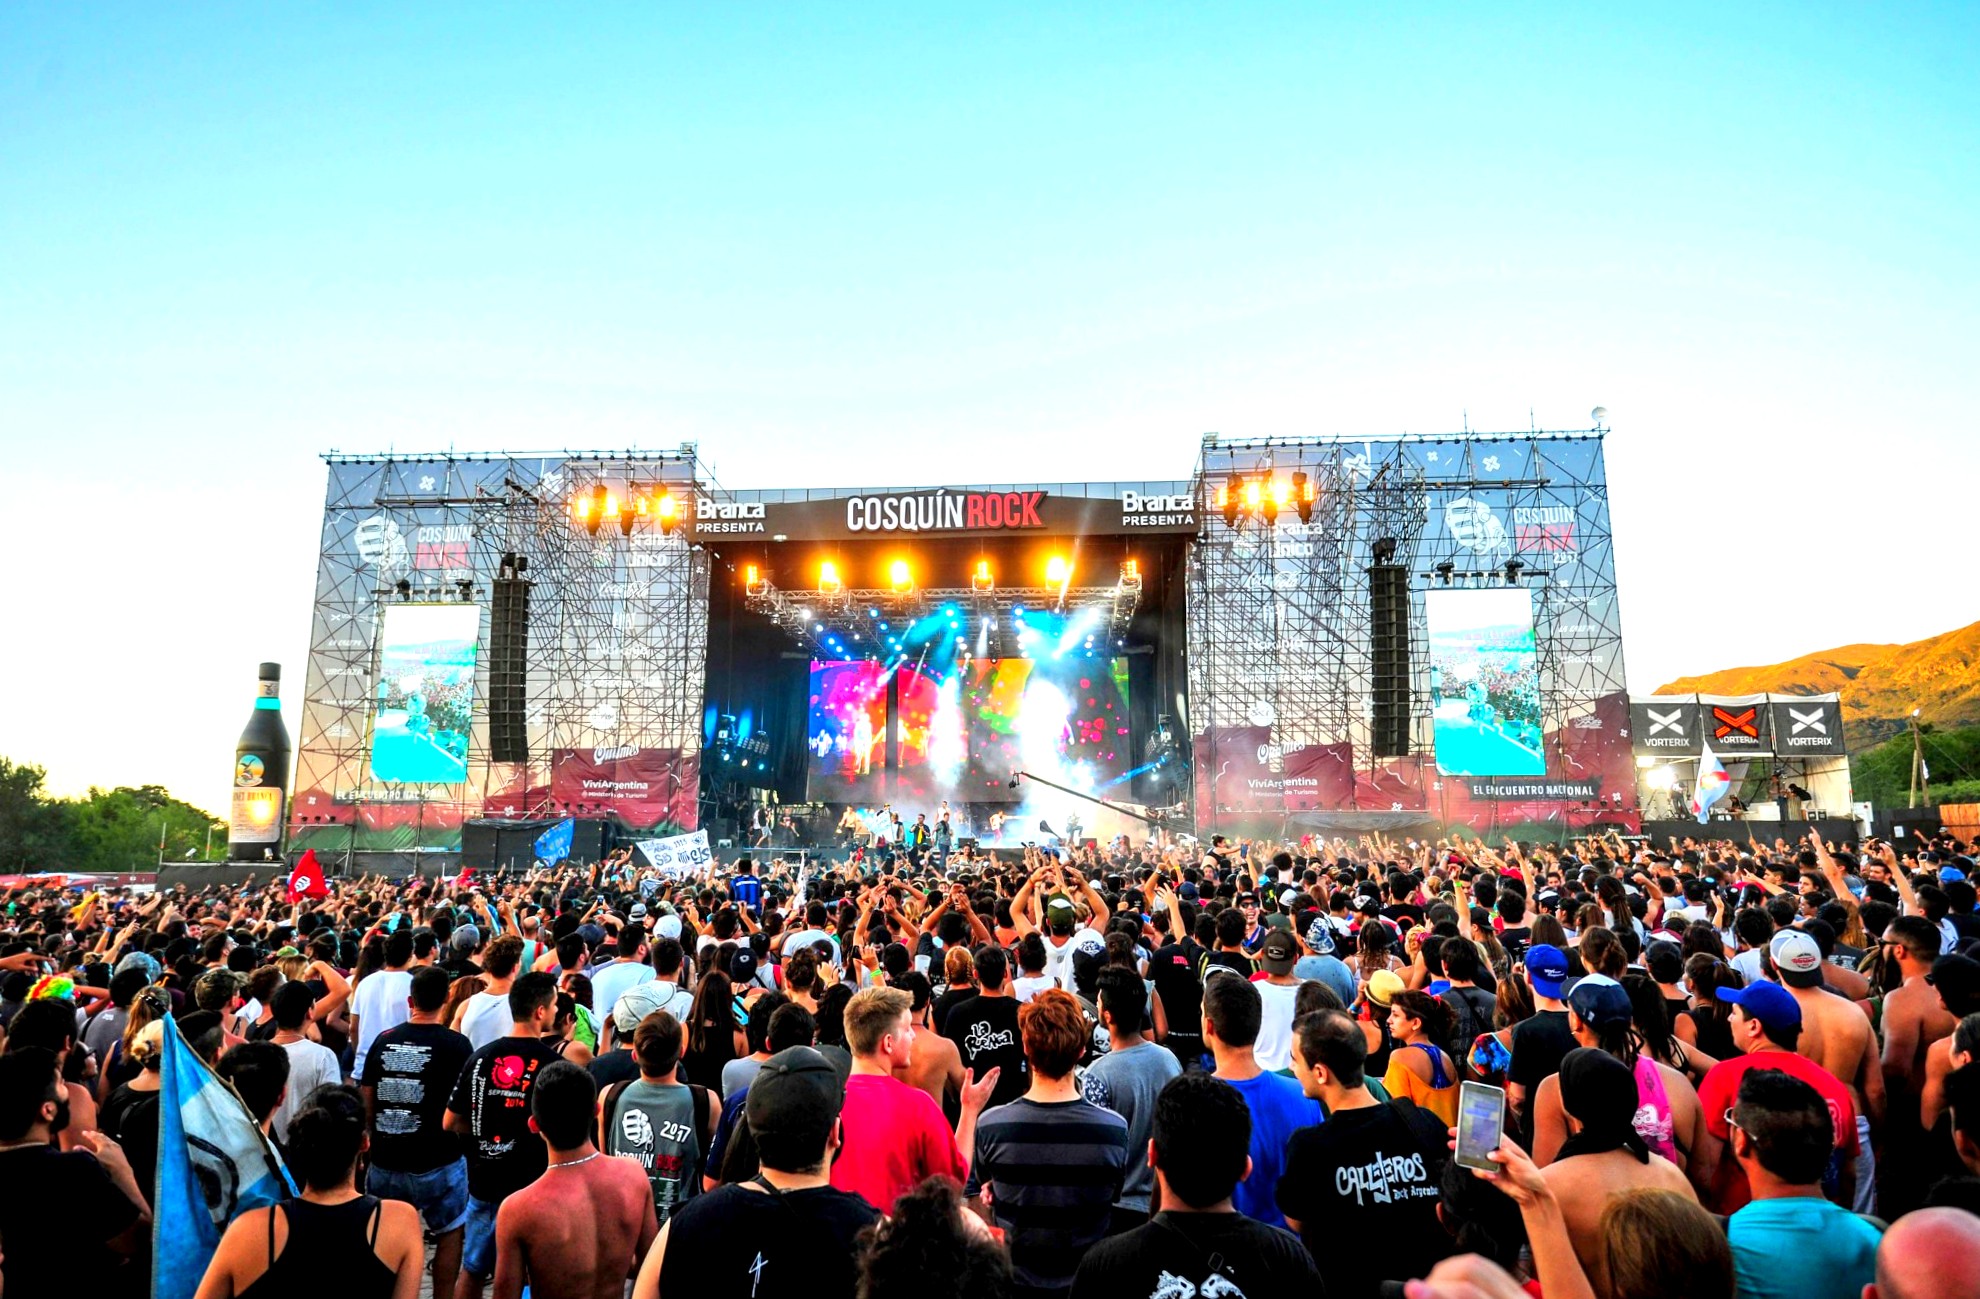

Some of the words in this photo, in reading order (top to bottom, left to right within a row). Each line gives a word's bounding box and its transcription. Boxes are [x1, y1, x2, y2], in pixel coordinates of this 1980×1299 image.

[1122, 490, 1195, 512] Branca
[697, 498, 766, 519] Branca
[847, 490, 965, 531] COSQUÍN
[967, 492, 1043, 528] ROCK
[1514, 503, 1576, 524] COSQUÍN
[1122, 514, 1194, 526] PRESENTA
[417, 524, 473, 542] COSQUÍN
[695, 522, 765, 533] PRESENTA
[1644, 738, 1690, 747] VORTERIX
[1786, 737, 1833, 747] VORTERIX
[582, 780, 648, 791] ViviArgentina
[1473, 785, 1484, 795] EL
[1546, 785, 1594, 796] NACIONAL
[403, 789, 448, 800] NACONAL
[527, 1059, 539, 1072] 3
[521, 1080, 531, 1092] 7
[505, 1098, 525, 1108] 2014
[660, 1120, 692, 1143] 2017
[1335, 1150, 1427, 1206] CALLEJEROS
